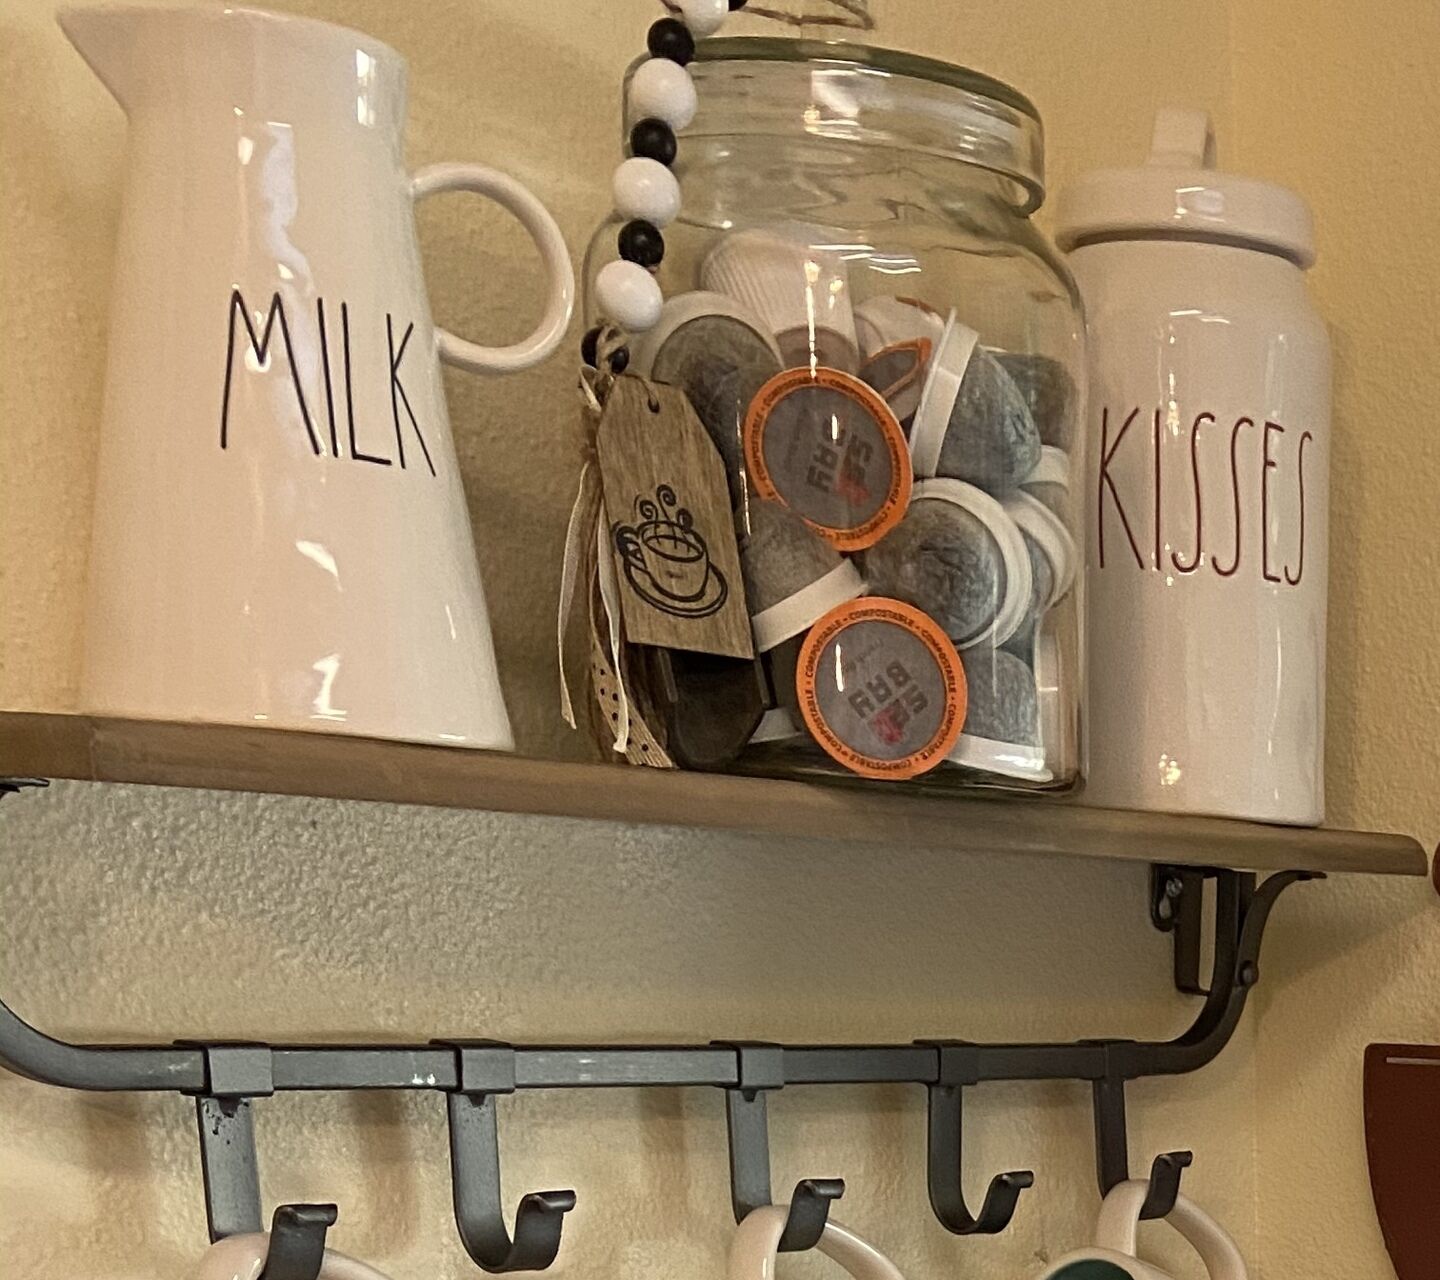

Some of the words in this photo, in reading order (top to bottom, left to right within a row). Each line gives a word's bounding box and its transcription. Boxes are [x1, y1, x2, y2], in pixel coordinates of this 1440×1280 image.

[221, 290, 436, 476] MILK
[1096, 407, 1313, 586] KISSES
[849, 608, 915, 630] COMPOSTABLE
[921, 629, 958, 694] COMPOSTABLE
